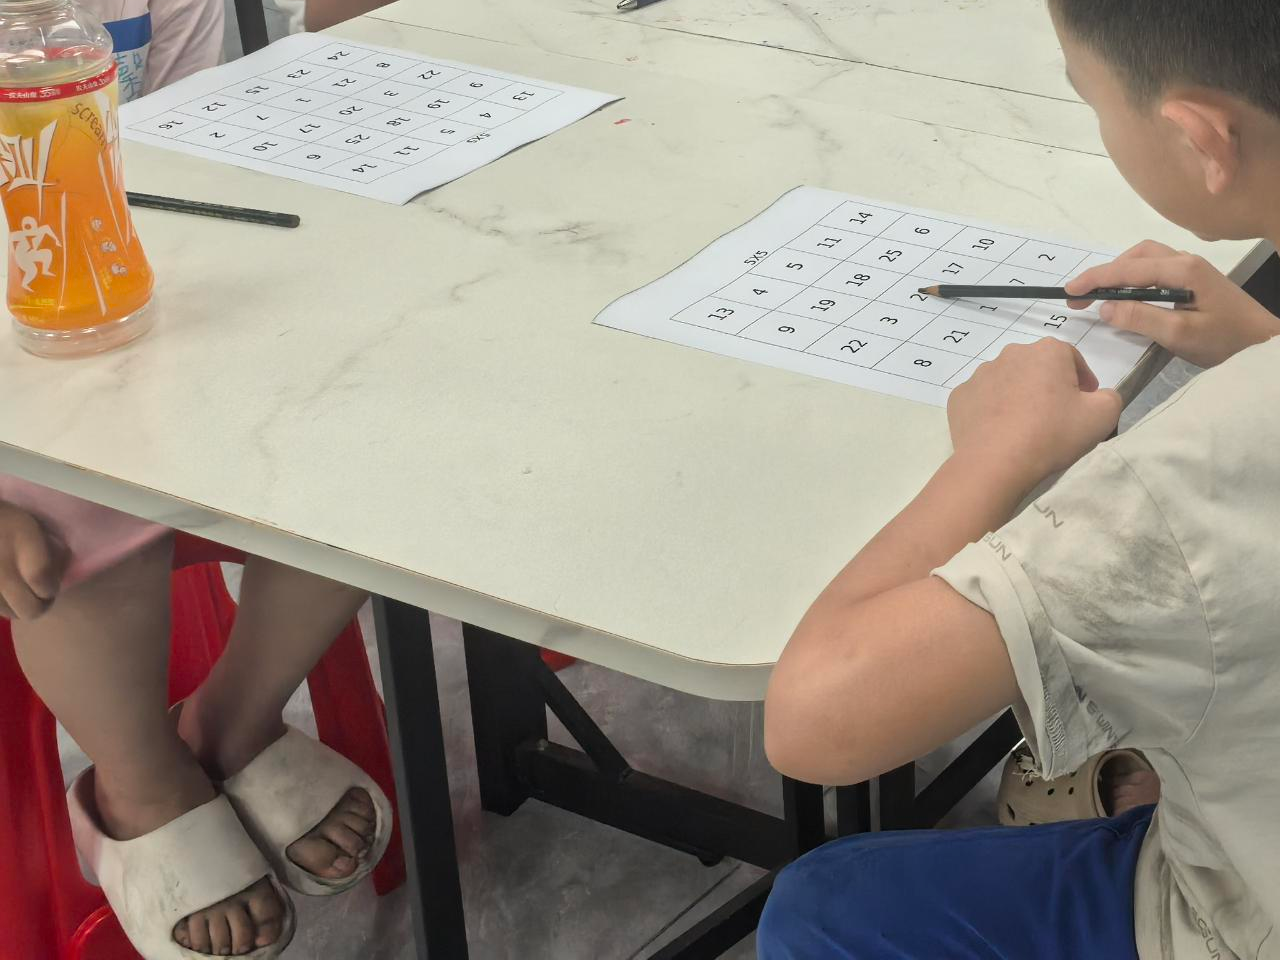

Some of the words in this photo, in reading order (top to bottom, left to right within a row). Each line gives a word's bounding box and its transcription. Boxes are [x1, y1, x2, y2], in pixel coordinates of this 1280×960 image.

[328, 51, 350, 61] 24
[287, 70, 311, 79] 23
[418, 70, 441, 80] 22
[332, 78, 356, 88] 21
[245, 86, 269, 95] 15
[513, 91, 534, 101] 13
[202, 102, 226, 112] 12
[428, 99, 450, 109] 19
[339, 106, 363, 116] 20
[159, 121, 183, 130] 16
[386, 117, 411, 127] 18
[299, 124, 320, 134] 17
[210, 131, 225, 139] 2
[345, 134, 369, 145] 25
[253, 142, 278, 152] 10
[393, 146, 419, 156] 11
[352, 164, 377, 173] 14
[708, 308, 734, 320] 13
[817, 238, 842, 248] 11
[849, 213, 872, 224] 14
[811, 300, 835, 311] 19
[846, 274, 870, 286] 18
[879, 250, 902, 262] 25
[841, 340, 868, 353] 22
[942, 263, 963, 274] 17
[972, 239, 994, 250] 10
[1044, 315, 1067, 328] 15
[914, 359, 932, 367] 8
[943, 331, 970, 343] 21
